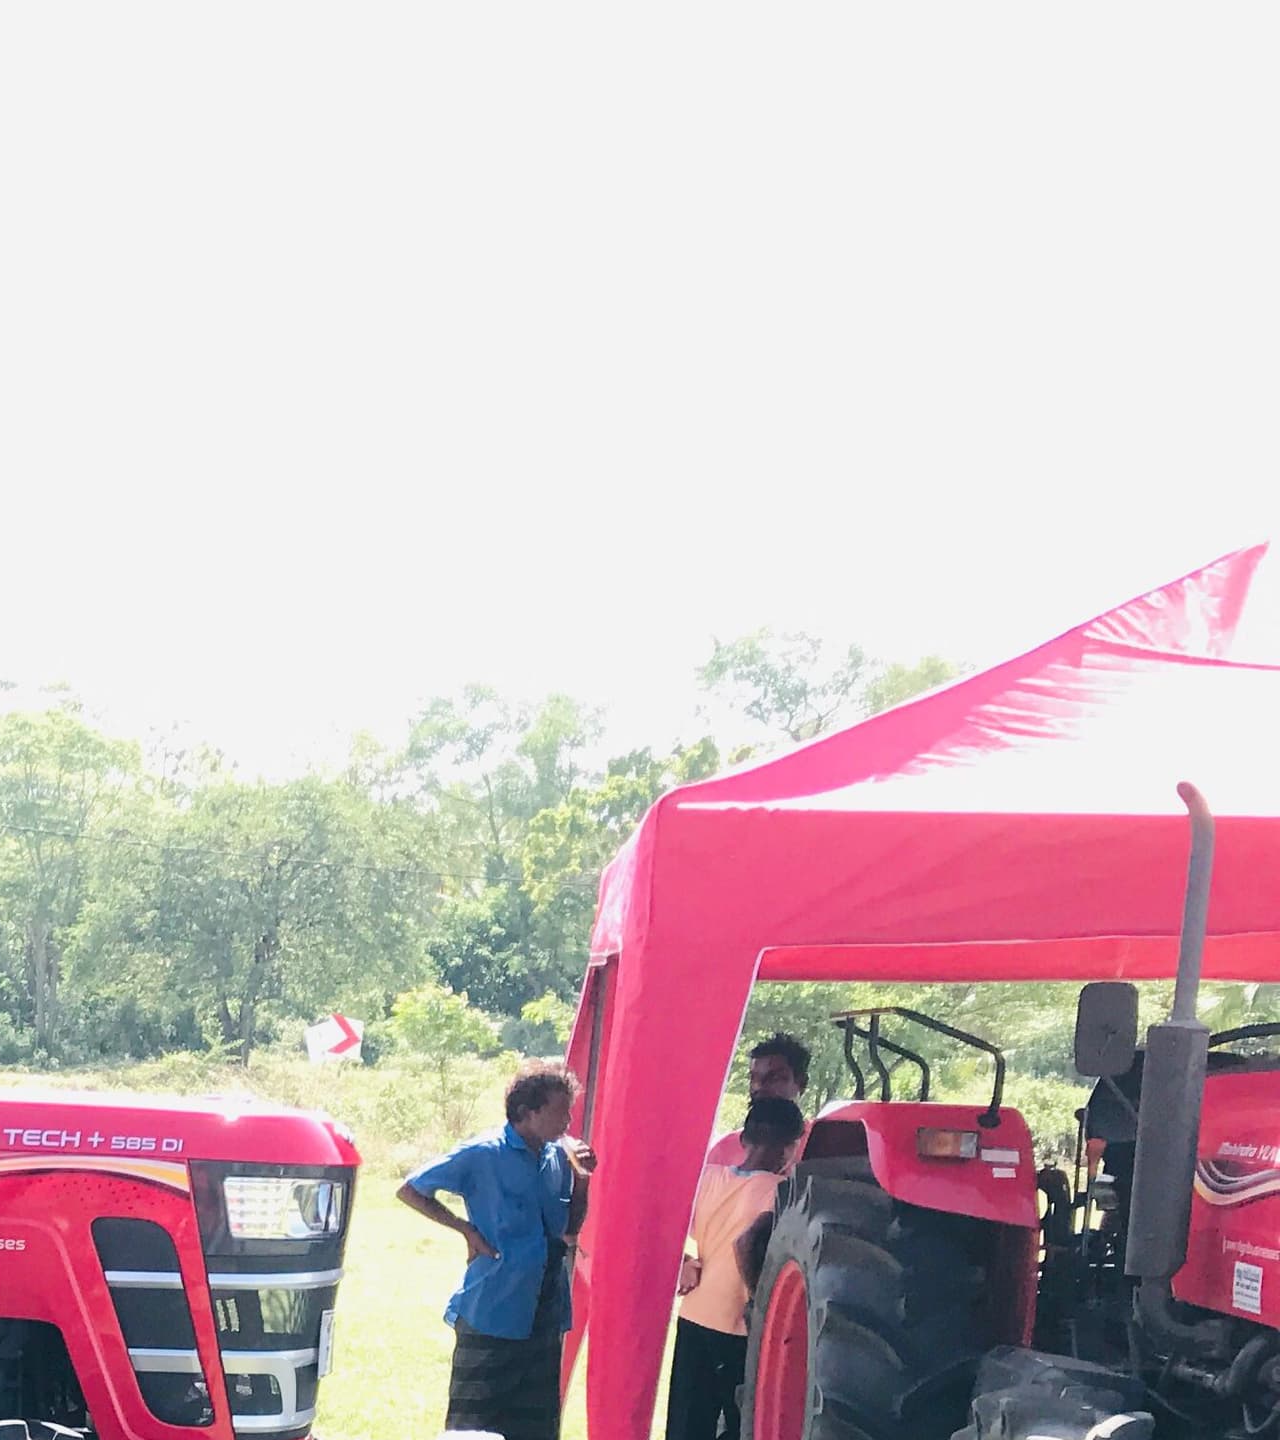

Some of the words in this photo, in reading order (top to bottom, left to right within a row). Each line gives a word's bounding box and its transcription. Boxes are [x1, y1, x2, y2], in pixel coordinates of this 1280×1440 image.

[3, 1128, 82, 1148] TECH
[87, 1131, 105, 1149] +
[111, 1136, 157, 1151] 585
[161, 1138, 184, 1152] DI
